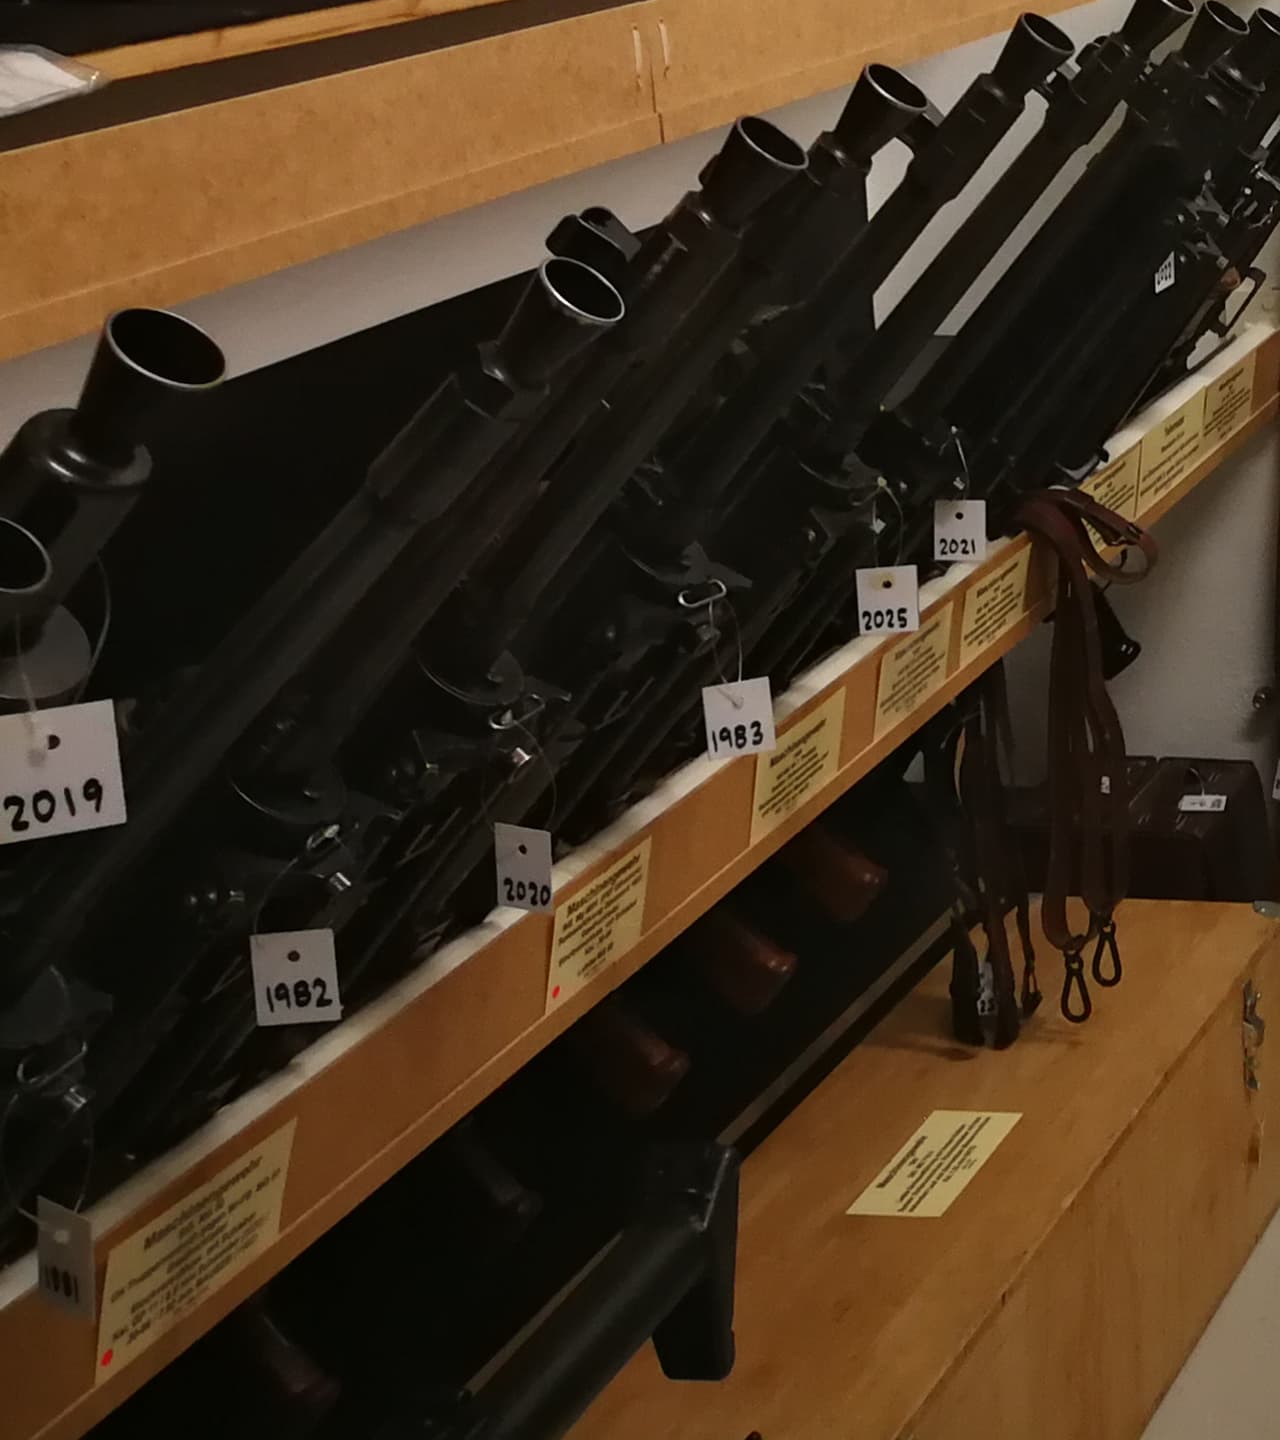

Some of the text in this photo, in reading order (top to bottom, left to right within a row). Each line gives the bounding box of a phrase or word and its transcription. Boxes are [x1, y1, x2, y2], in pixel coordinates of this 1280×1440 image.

[939, 538, 976, 556] 2021
[862, 607, 908, 631] 2025
[711, 720, 764, 753] 1983
[3, 777, 104, 833] 2019
[504, 877, 552, 907] 2020
[266, 977, 334, 1014] 1982
